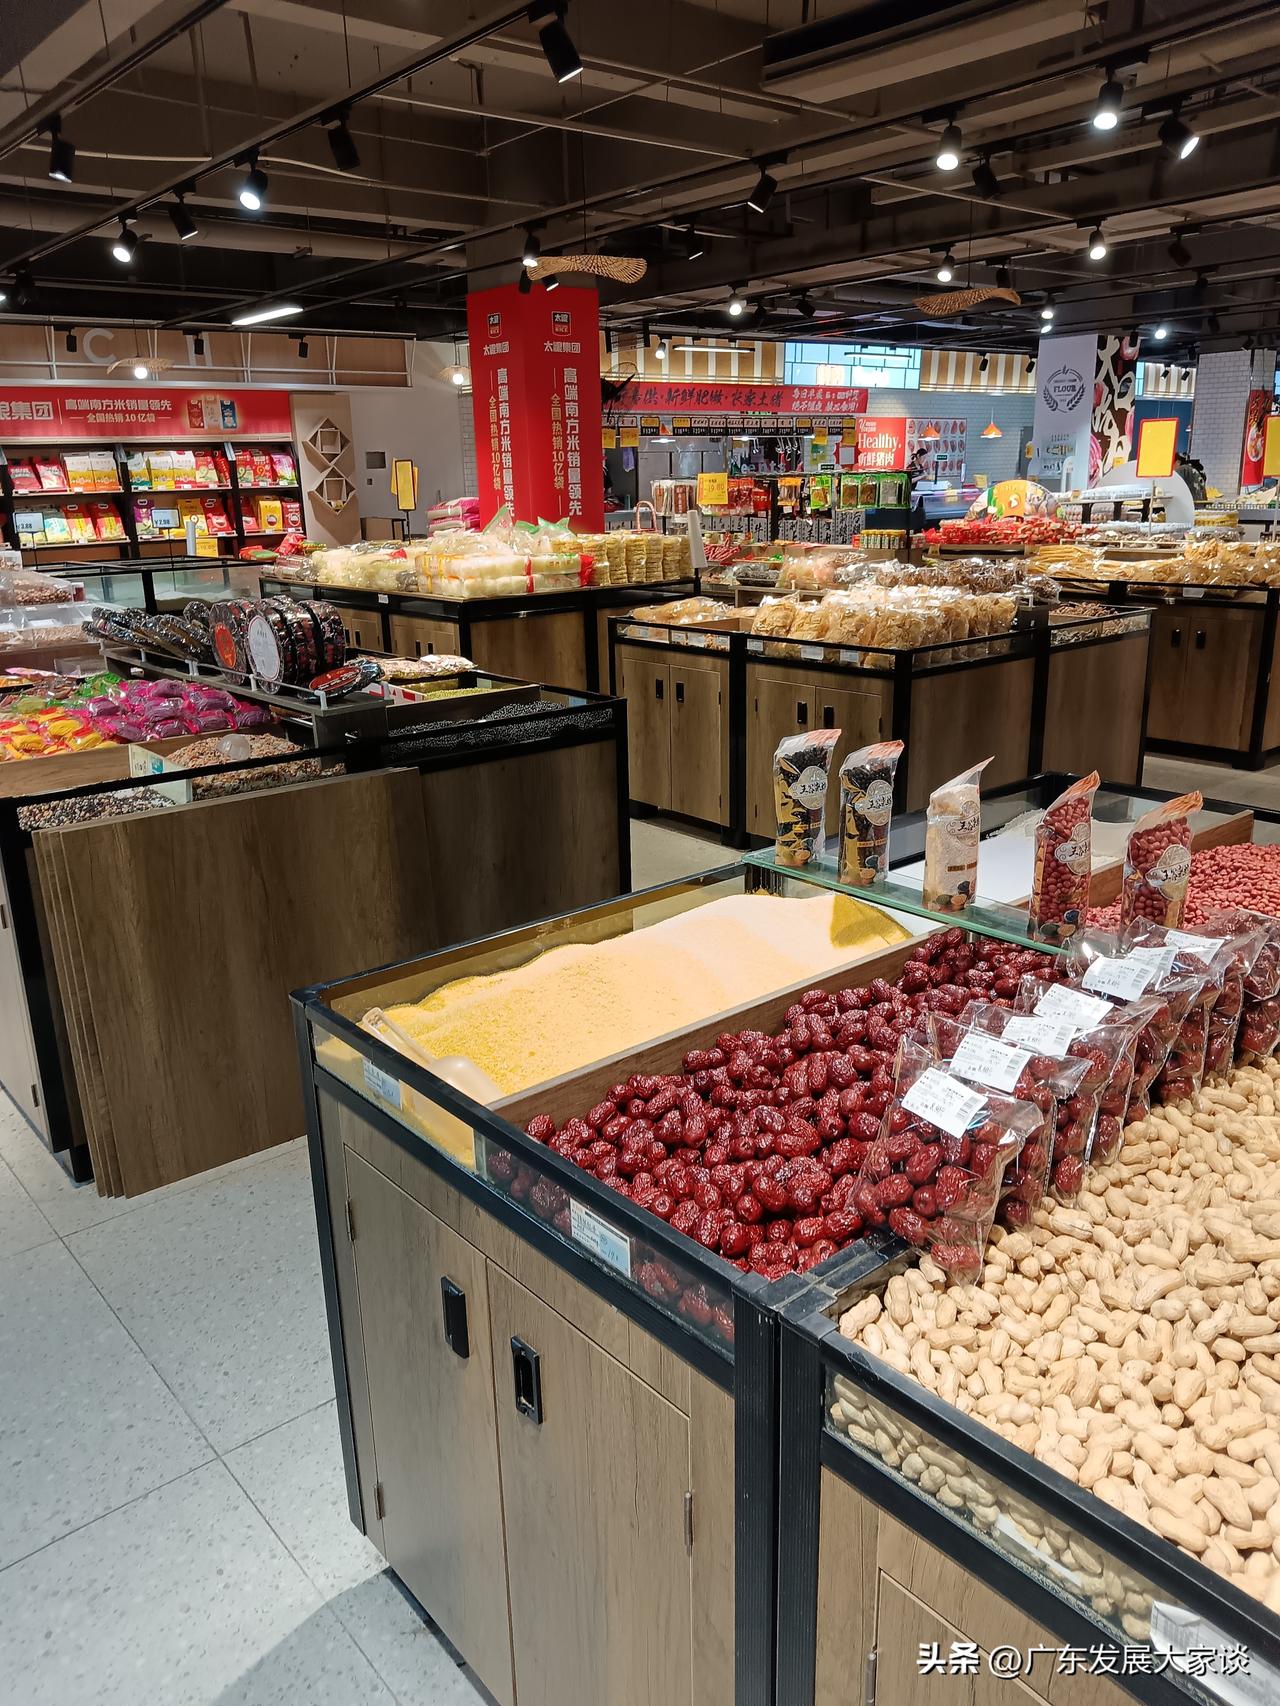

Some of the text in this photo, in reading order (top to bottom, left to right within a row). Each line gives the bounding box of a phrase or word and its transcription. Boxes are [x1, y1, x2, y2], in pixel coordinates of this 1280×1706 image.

[543, 340, 581, 354] 太粮集团
[1053, 385, 1077, 393] FLOUR
[65, 398, 172, 411] 高端南方米销量领先
[551, 393, 565, 490] 全国热销10亿袋
[563, 367, 582, 516] 高端南方米销量领先
